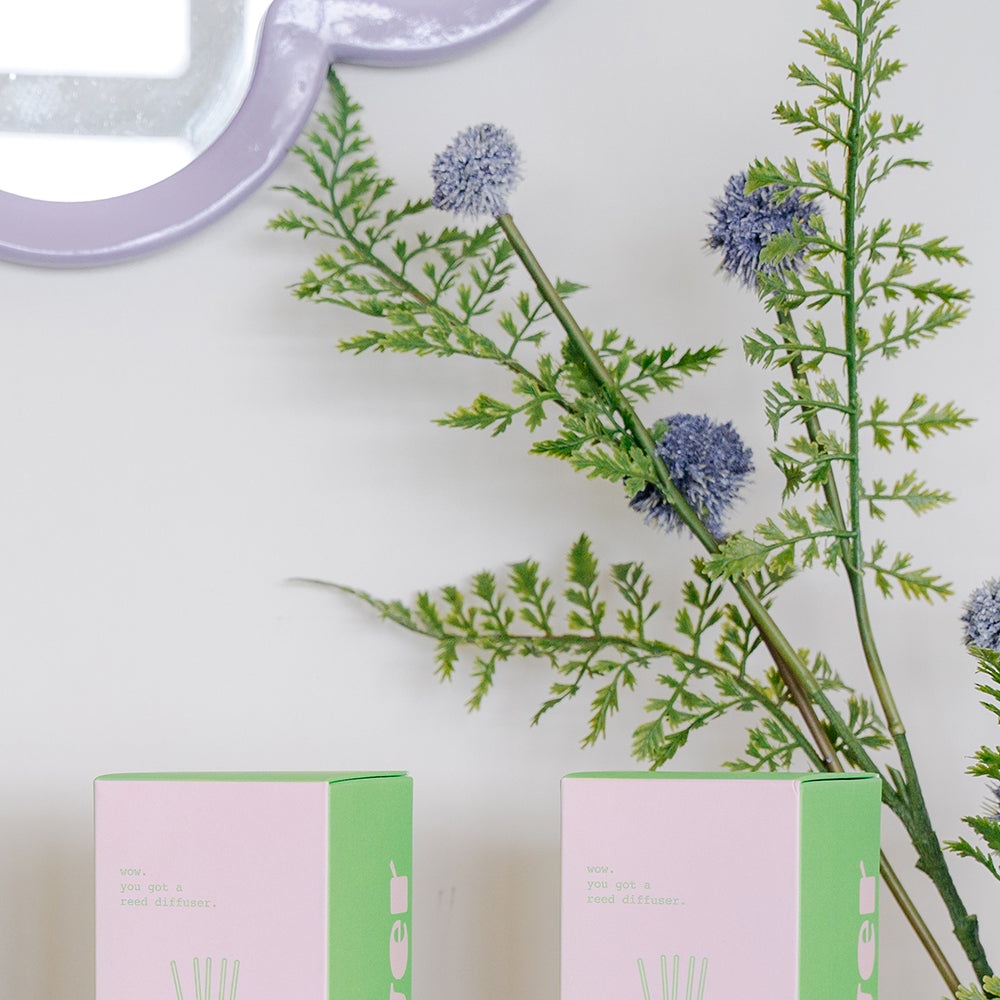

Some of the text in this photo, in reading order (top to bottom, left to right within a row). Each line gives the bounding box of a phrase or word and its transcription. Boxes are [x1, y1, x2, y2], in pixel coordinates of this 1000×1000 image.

[119, 868, 146, 876] wow.
[586, 865, 614, 874] wow.
[120, 882, 141, 893] you
[147, 883, 168, 893] got
[587, 880, 608, 890] you
[615, 880, 637, 891] got
[120, 897, 217, 908] reed diffuser.
[586, 894, 686, 905] reed diffuser.
